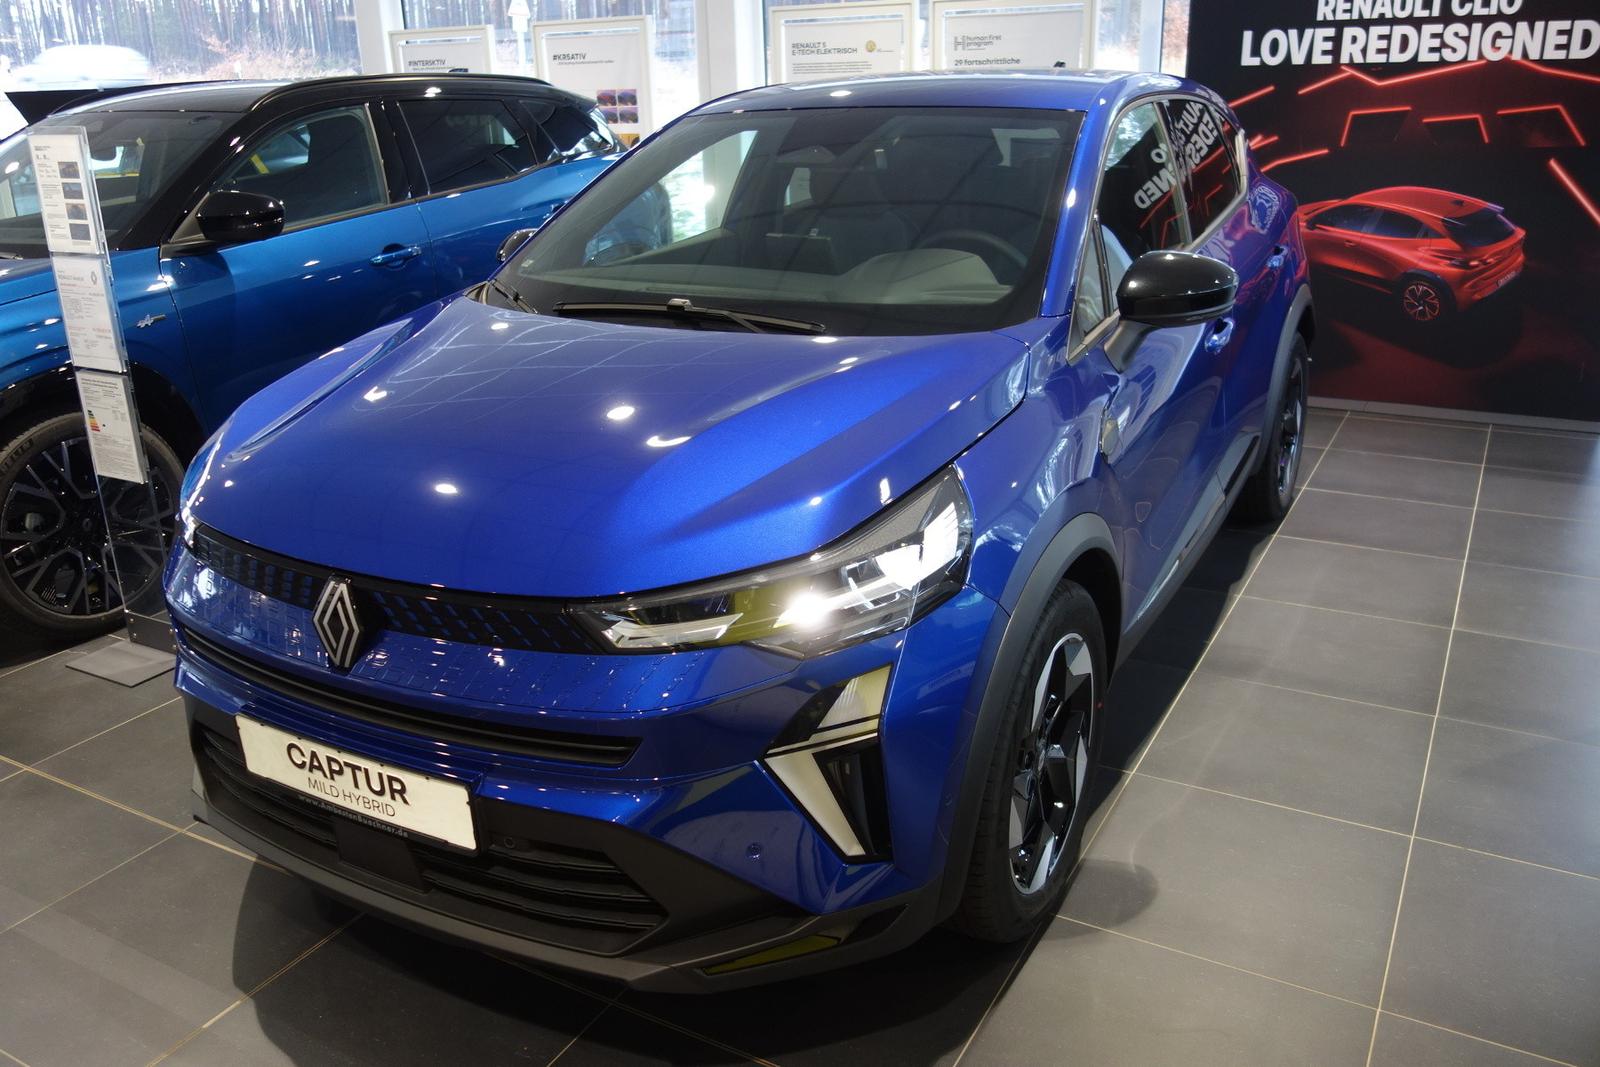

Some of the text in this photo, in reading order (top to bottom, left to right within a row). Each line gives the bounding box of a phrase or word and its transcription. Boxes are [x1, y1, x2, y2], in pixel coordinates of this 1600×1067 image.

[1316, 0, 1523, 21] RENAULT CLIO
[1240, 20, 1600, 66] LOVE REDESIGNED
[286, 742, 409, 805] CAPTUR
[307, 777, 396, 818] MILD HYBRID
